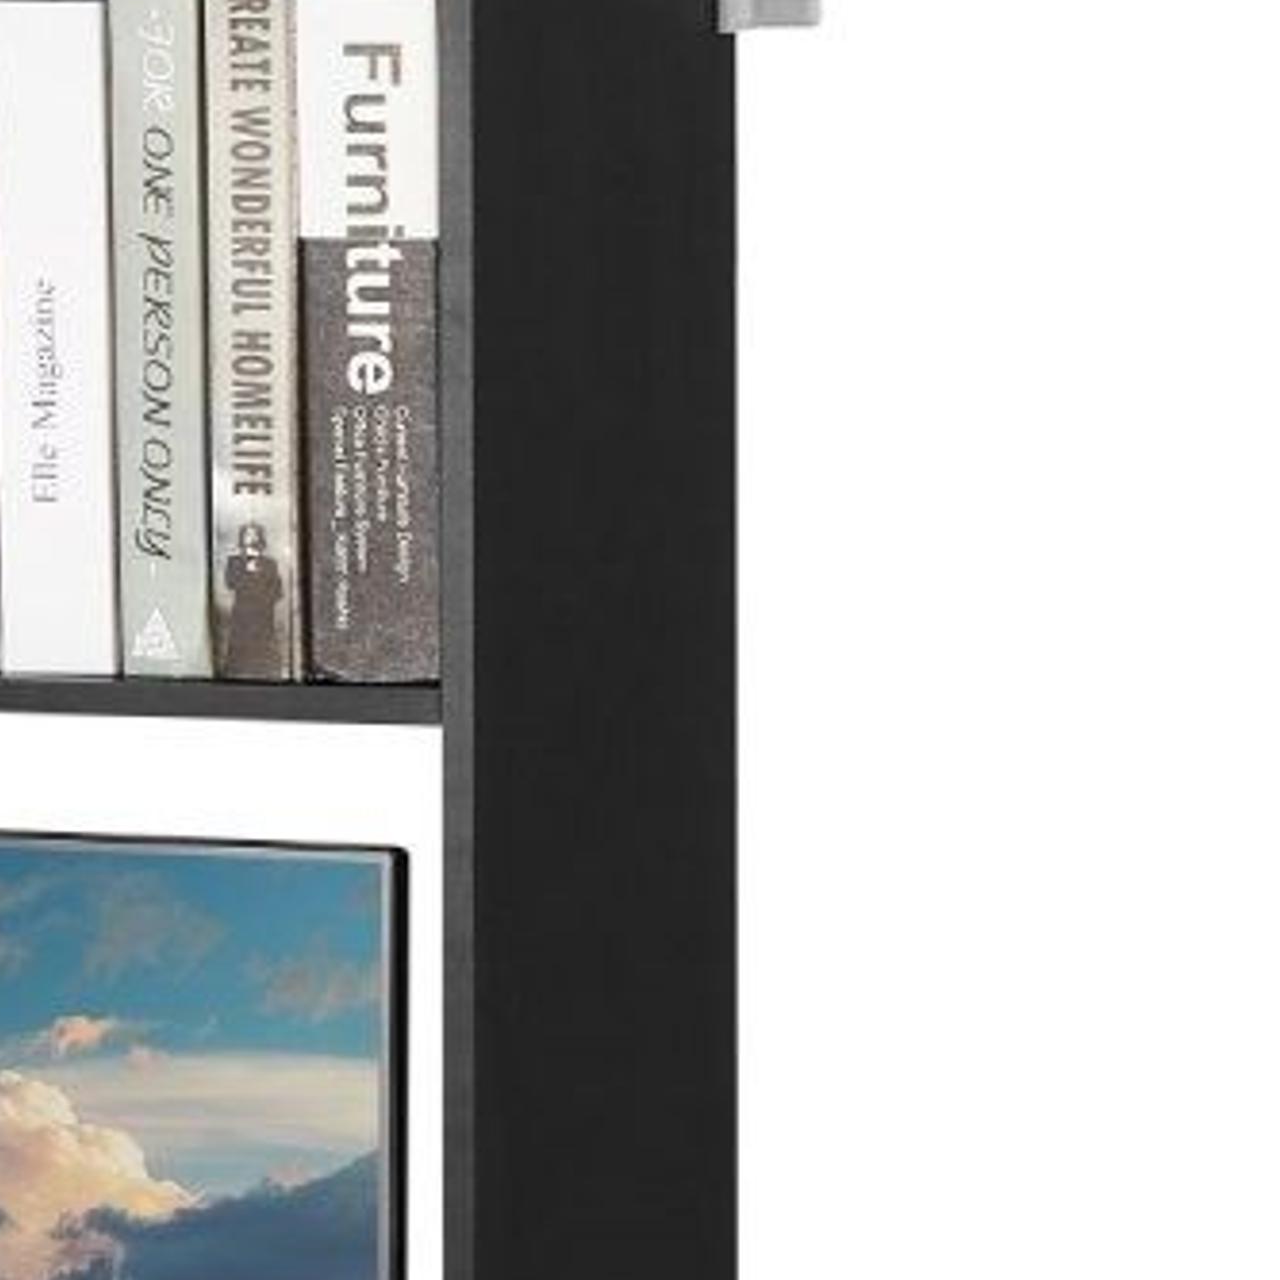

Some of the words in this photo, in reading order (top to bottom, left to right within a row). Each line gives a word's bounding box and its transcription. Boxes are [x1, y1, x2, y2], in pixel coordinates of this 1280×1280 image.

[142, 125, 175, 218] ONE
[230, 105, 274, 316] WONDERFUL
[342, 43, 405, 396] Furniture
[31, 277, 64, 429] Magazine
[137, 231, 175, 427] PERSON
[232, 330, 275, 498] HOMELIFE
